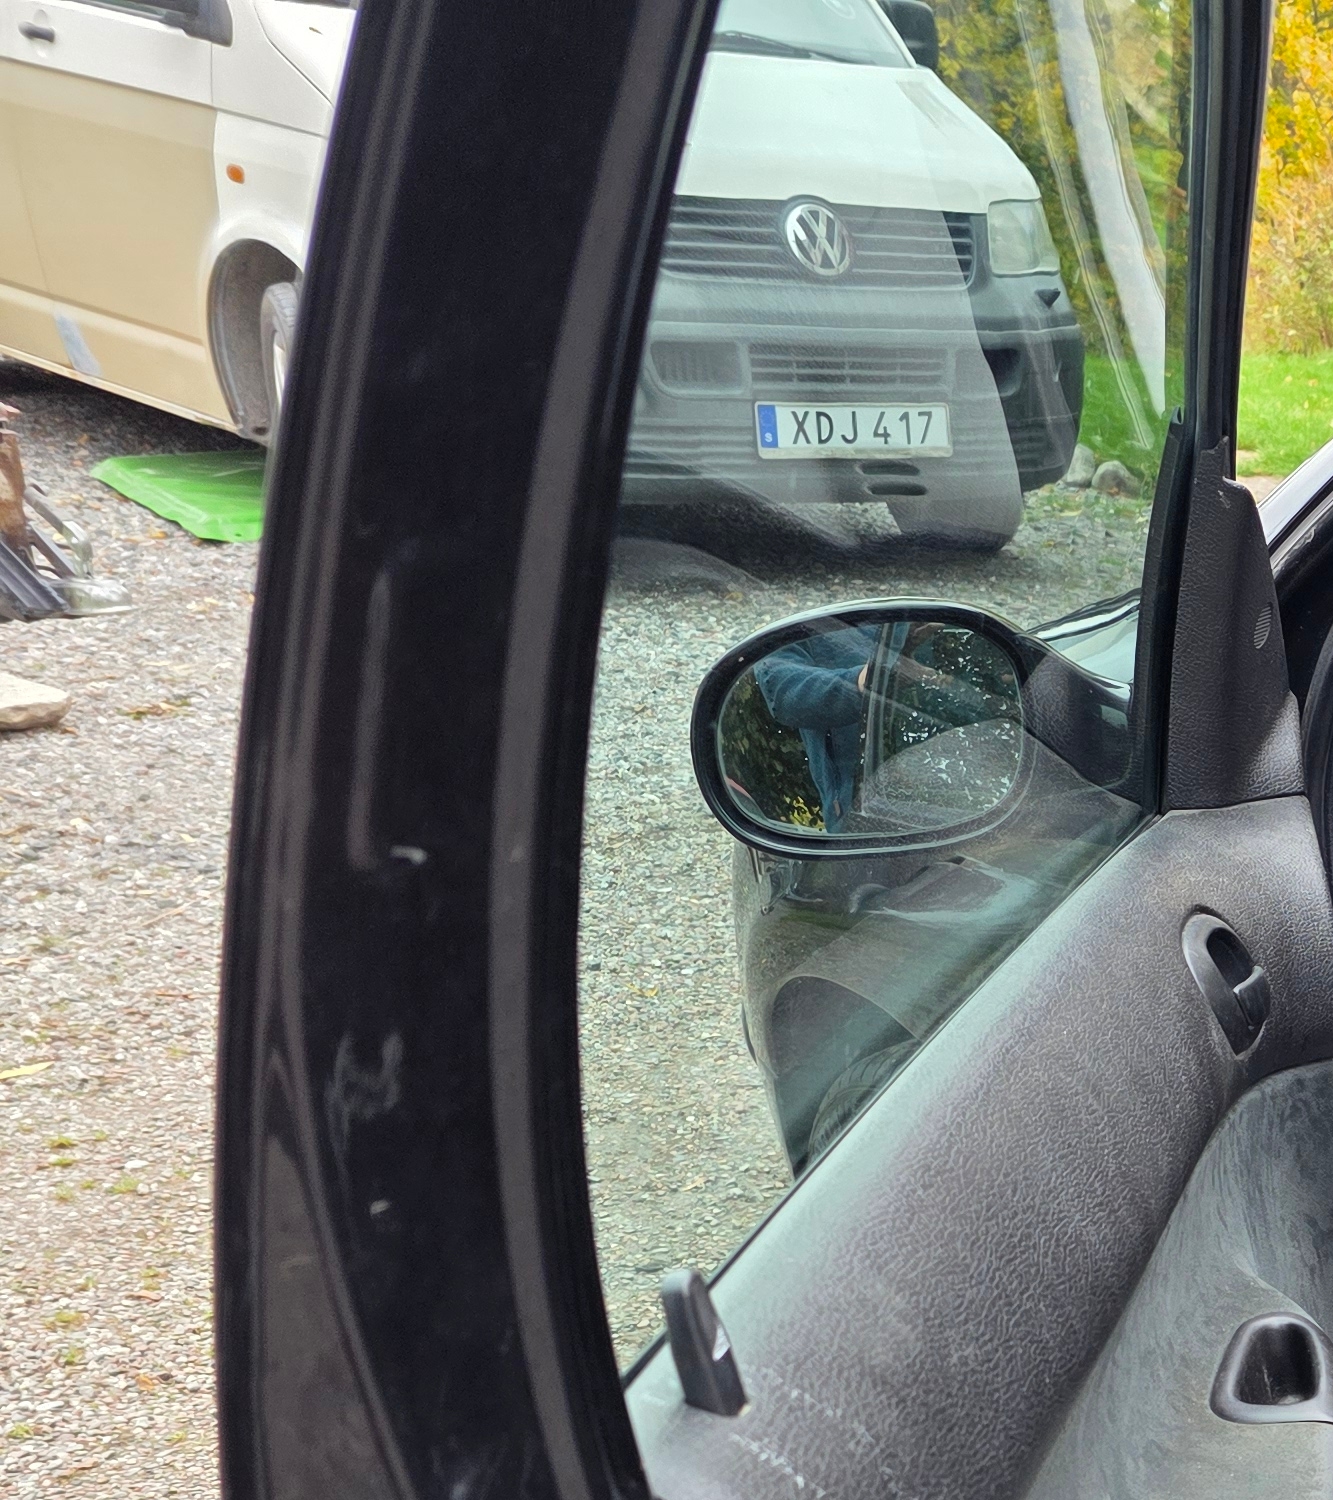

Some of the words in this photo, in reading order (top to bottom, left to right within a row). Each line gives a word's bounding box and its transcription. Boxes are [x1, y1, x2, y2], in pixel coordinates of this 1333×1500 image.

[764, 432, 773, 443] S
[791, 411, 858, 445] XDJ
[873, 411, 933, 445] 417
